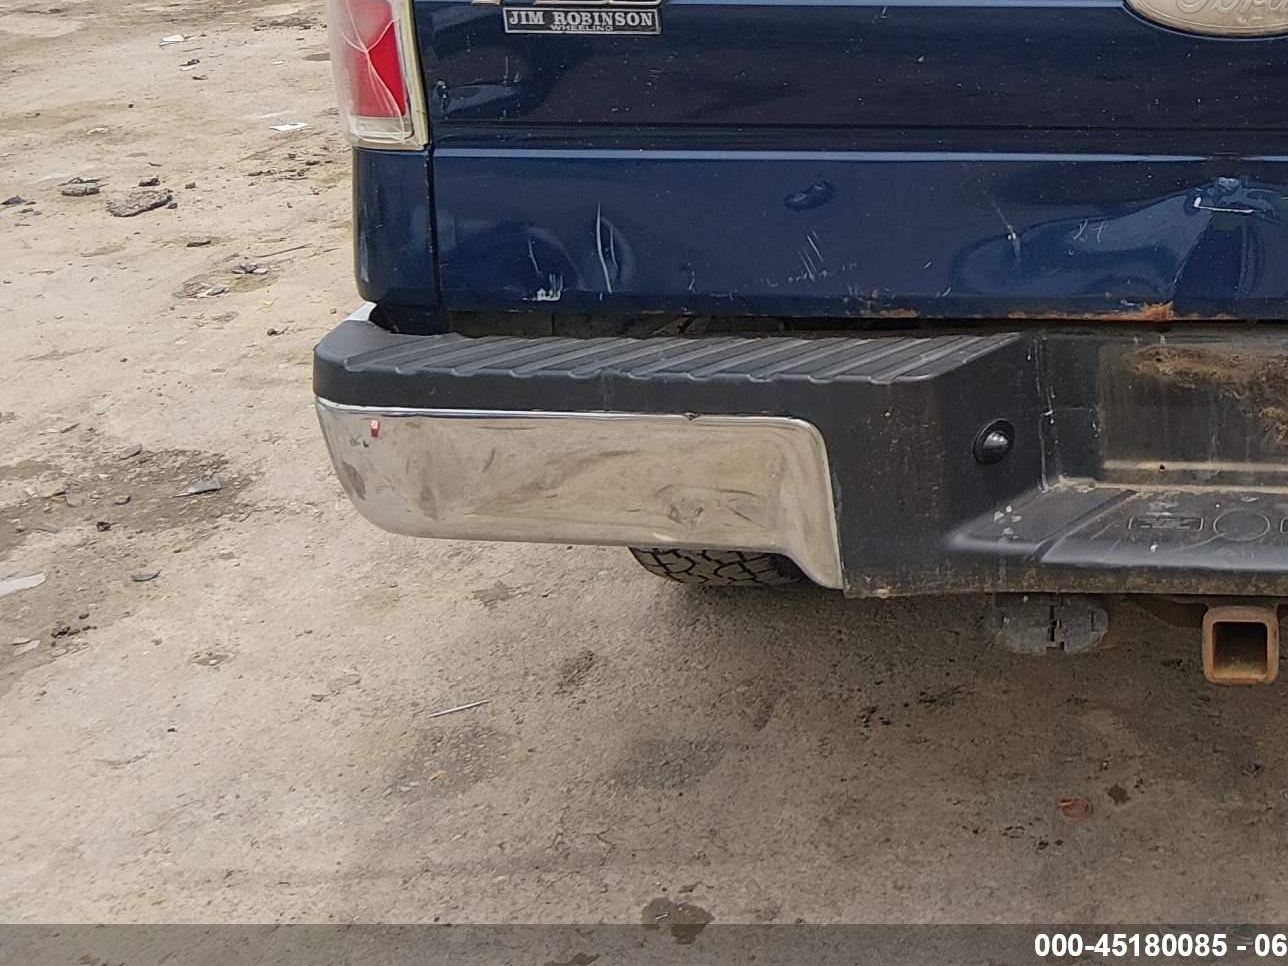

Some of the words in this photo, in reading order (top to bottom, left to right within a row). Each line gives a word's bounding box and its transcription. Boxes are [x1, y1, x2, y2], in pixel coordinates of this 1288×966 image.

[509, 10, 546, 25] JIM
[552, 11, 653, 26] ROBINSON
[550, 24, 614, 32] WHEELING
